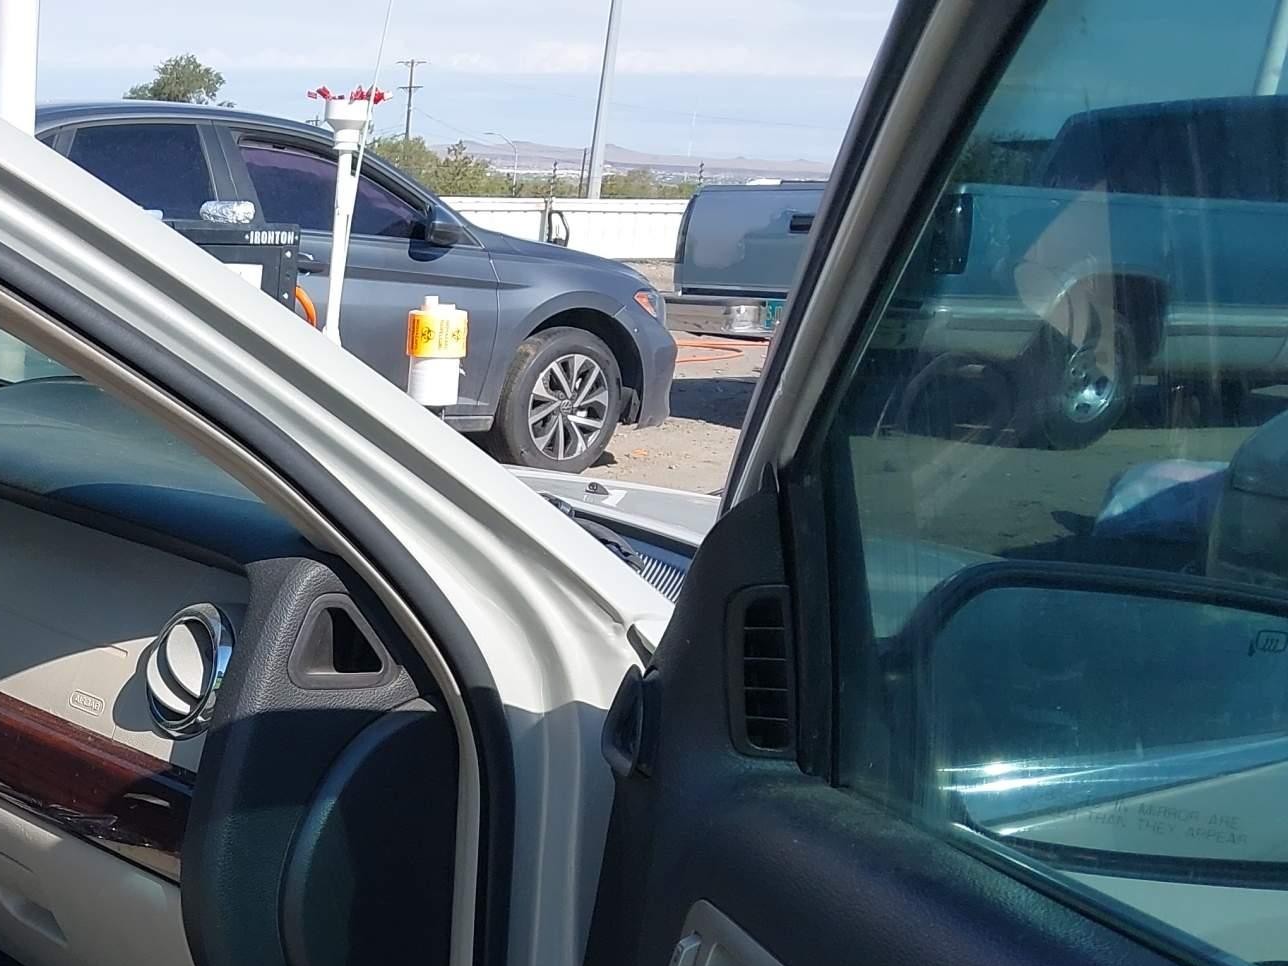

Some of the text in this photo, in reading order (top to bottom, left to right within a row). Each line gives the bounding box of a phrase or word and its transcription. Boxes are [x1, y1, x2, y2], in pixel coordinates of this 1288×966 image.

[249, 231, 295, 245] IRONTON
[1208, 813, 1241, 830] ARE
[1136, 818, 1177, 835] THEY
[1184, 827, 1249, 845] APPEAR
